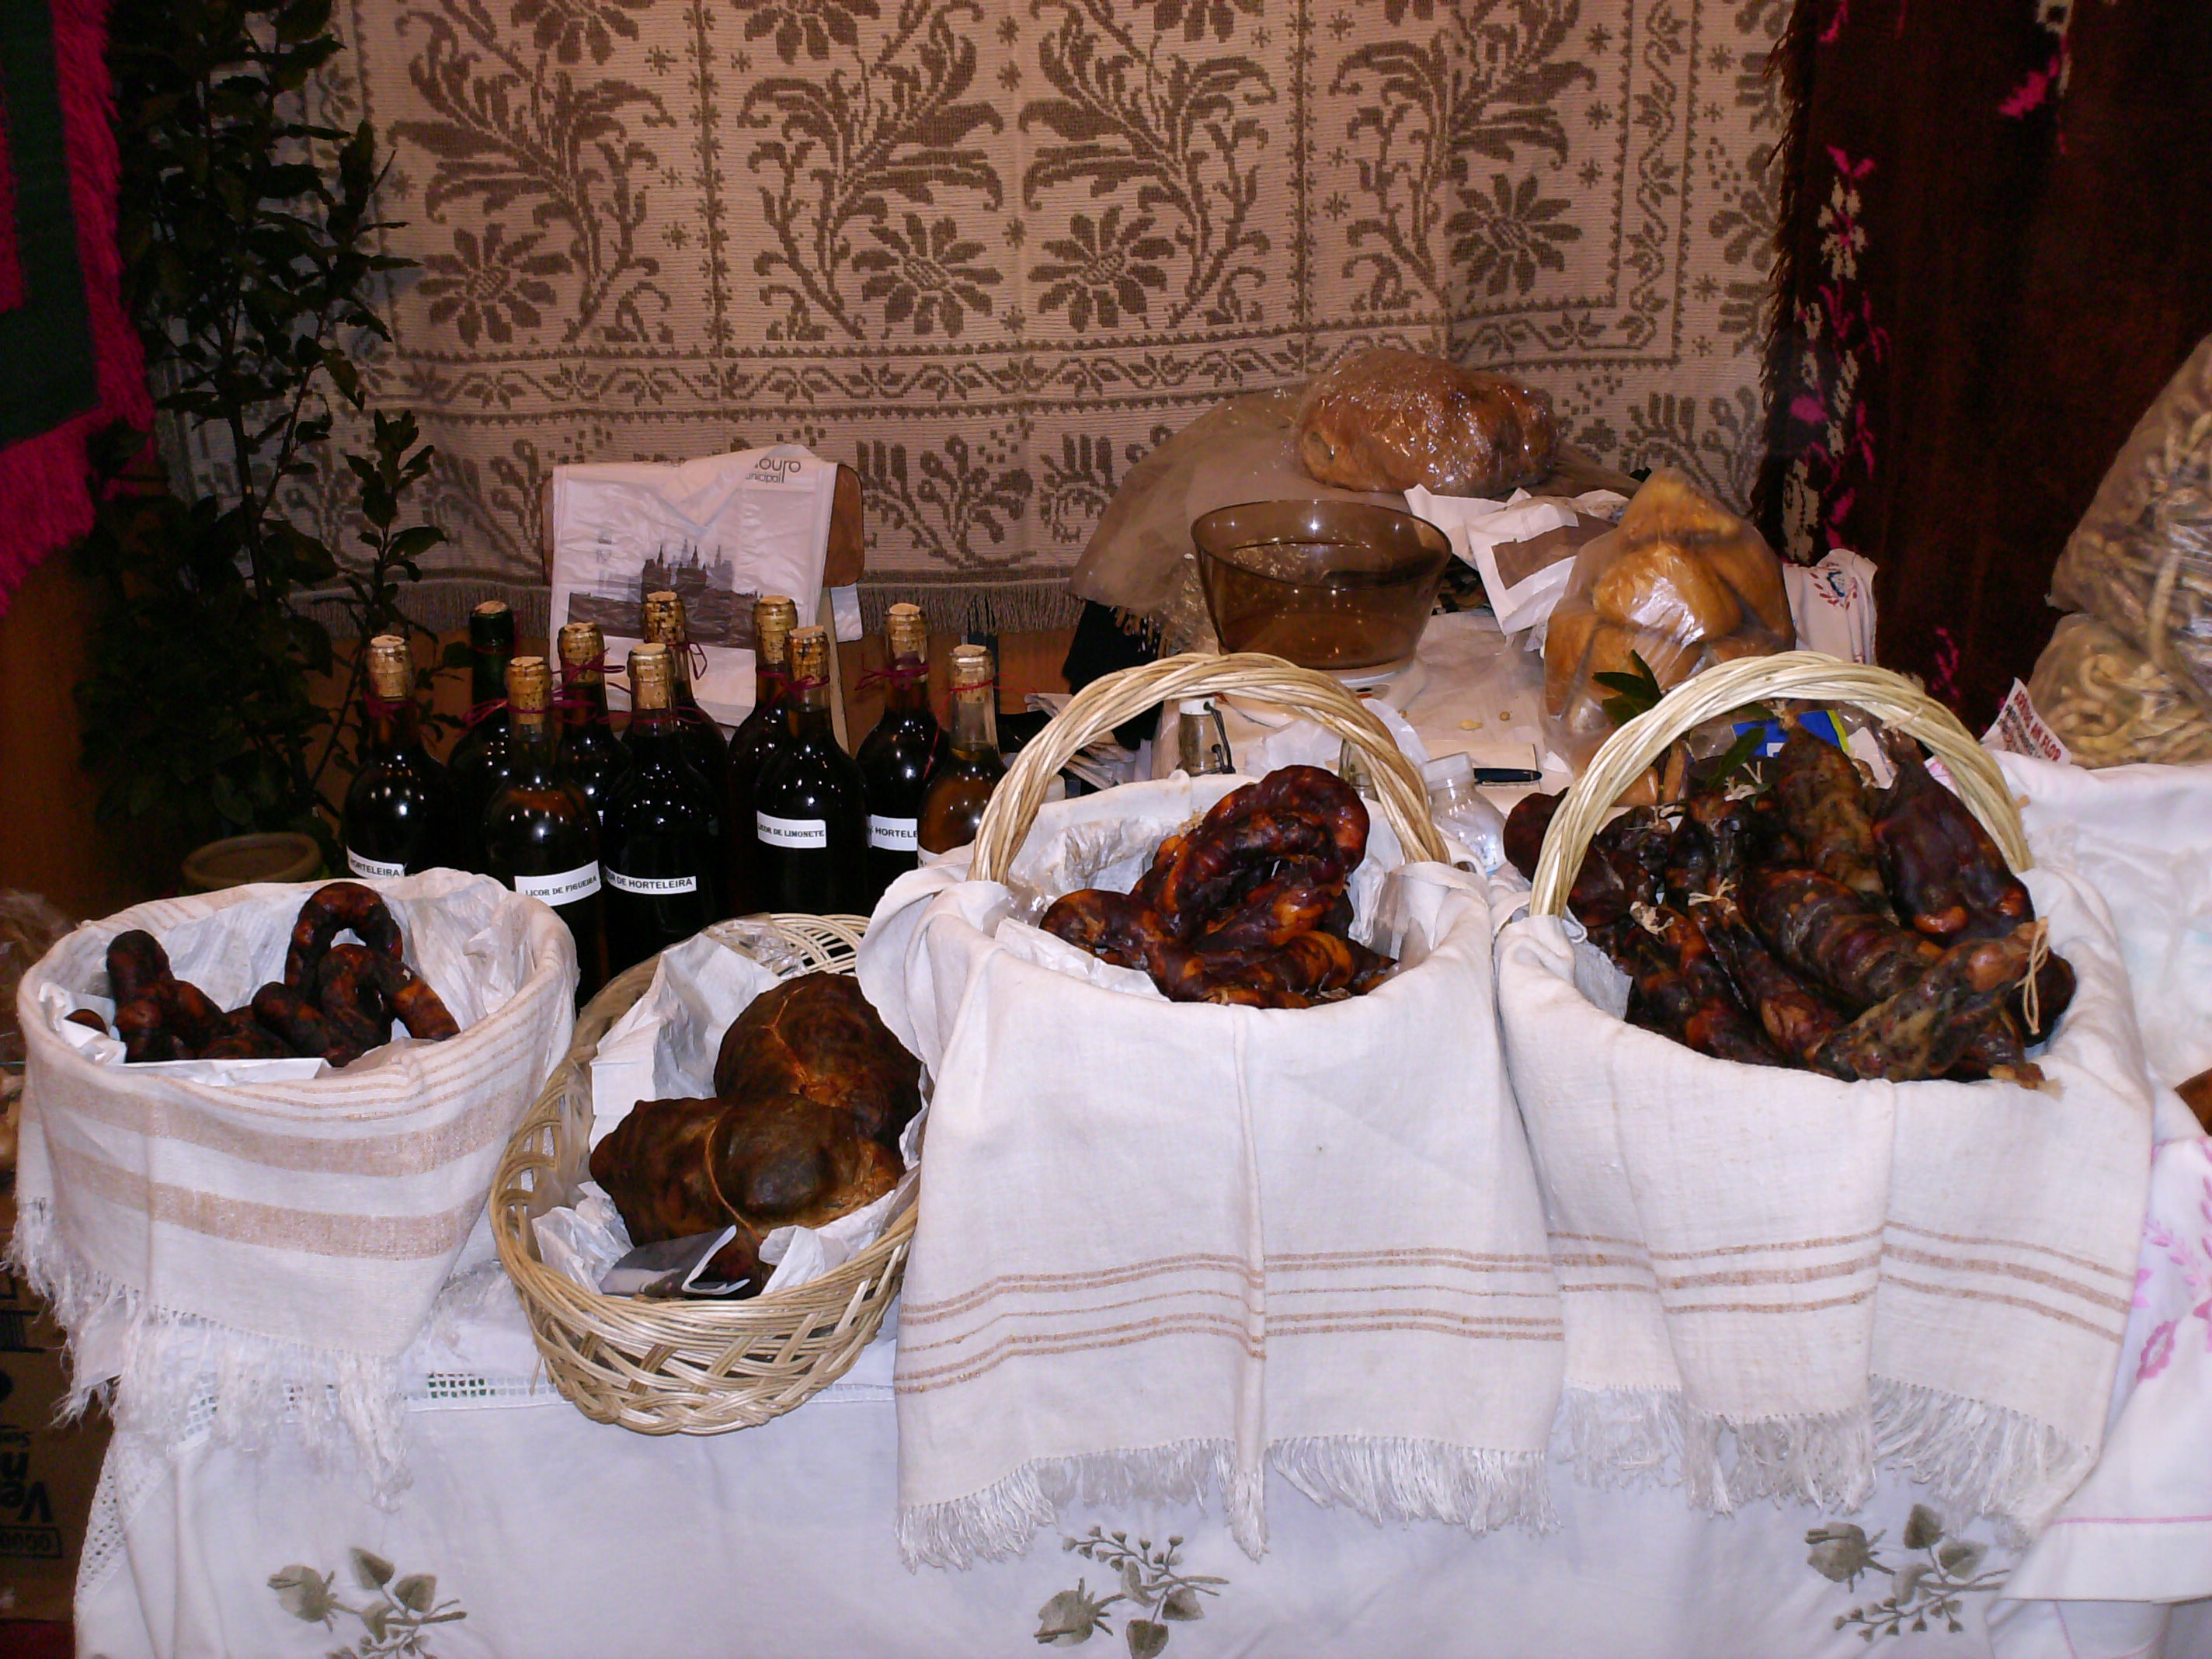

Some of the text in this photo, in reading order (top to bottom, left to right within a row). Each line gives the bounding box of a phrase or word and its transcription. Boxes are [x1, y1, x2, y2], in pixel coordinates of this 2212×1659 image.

[754, 458, 801, 483] ouro
[773, 828, 783, 836] DE
[784, 830, 825, 838] LIMONETE
[565, 875, 597, 892] FIGUEIRA
[616, 875, 628, 886] DE
[628, 878, 694, 889] HORTELEIRA
